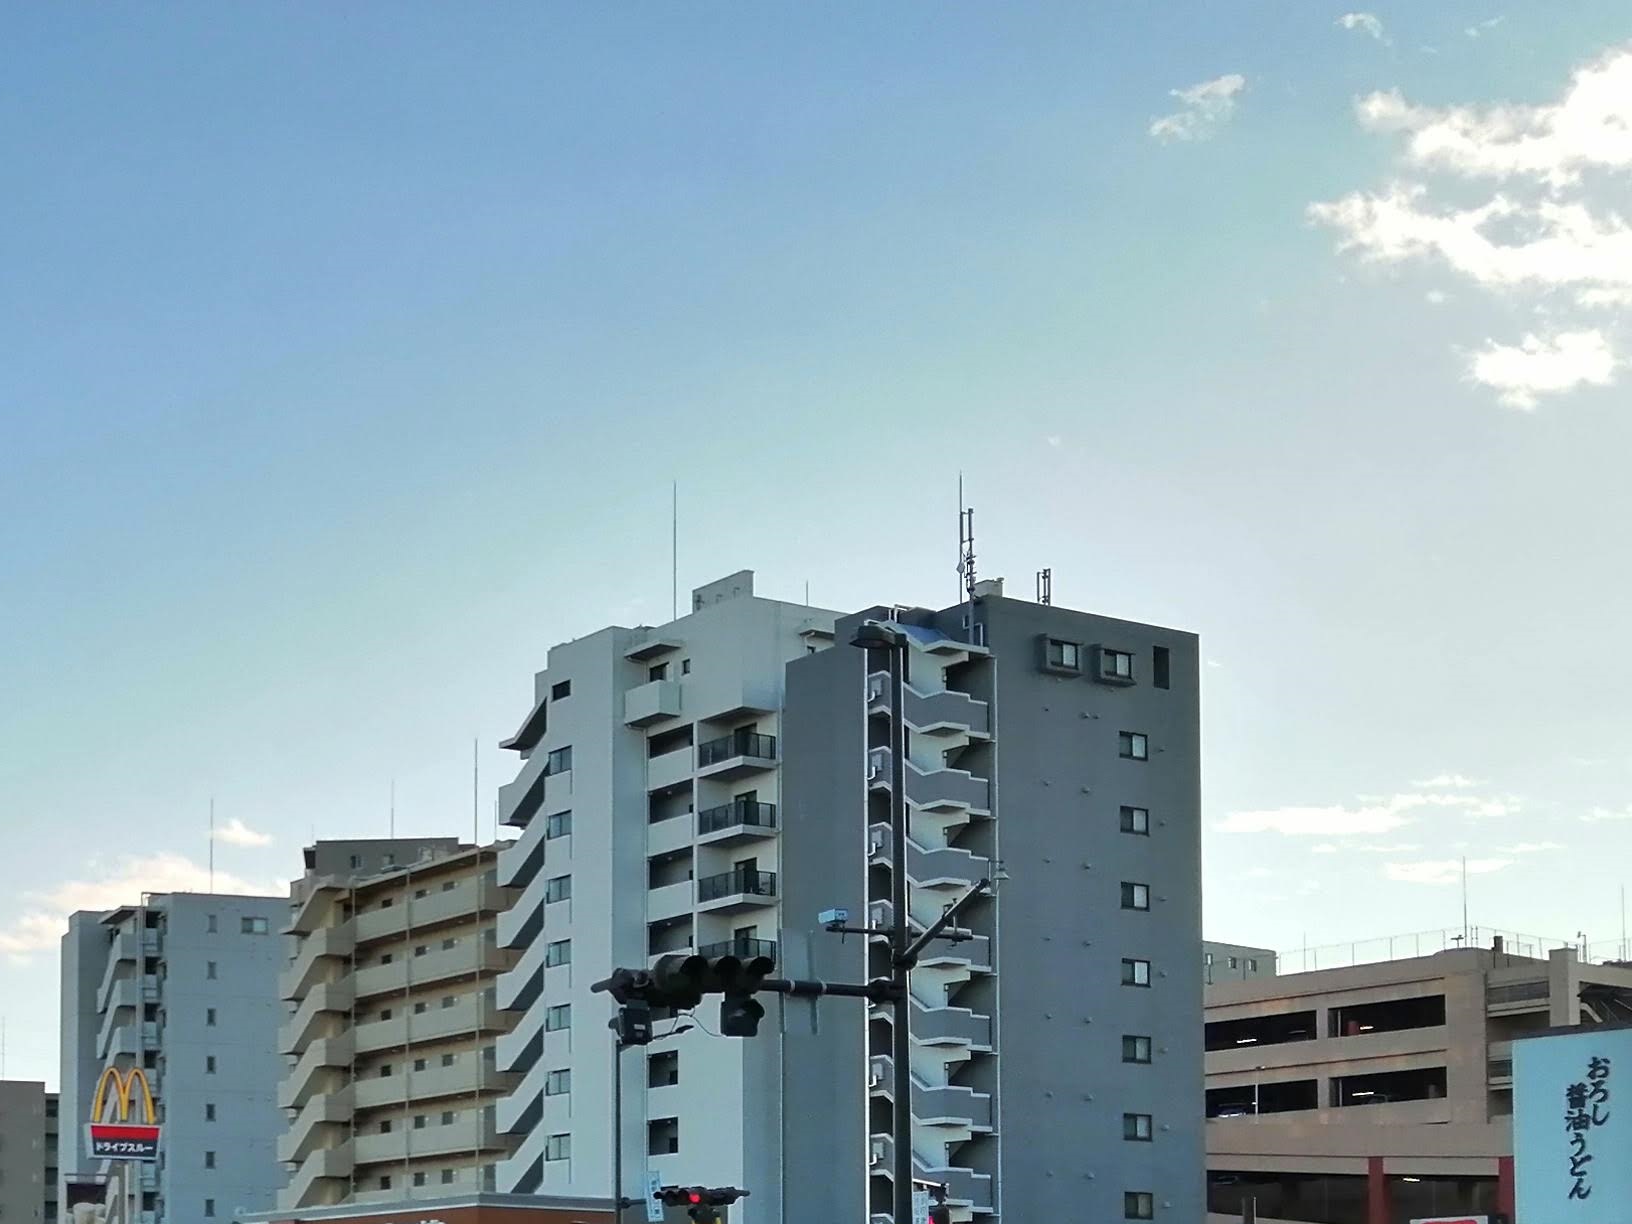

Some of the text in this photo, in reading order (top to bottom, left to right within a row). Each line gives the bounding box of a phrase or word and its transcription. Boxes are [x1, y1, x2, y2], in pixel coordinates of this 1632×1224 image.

[1587, 1056, 1611, 1127] おろし
[95, 1142, 154, 1153] ドライブスルー
[1564, 1082, 1594, 1201] 醤油うどん
